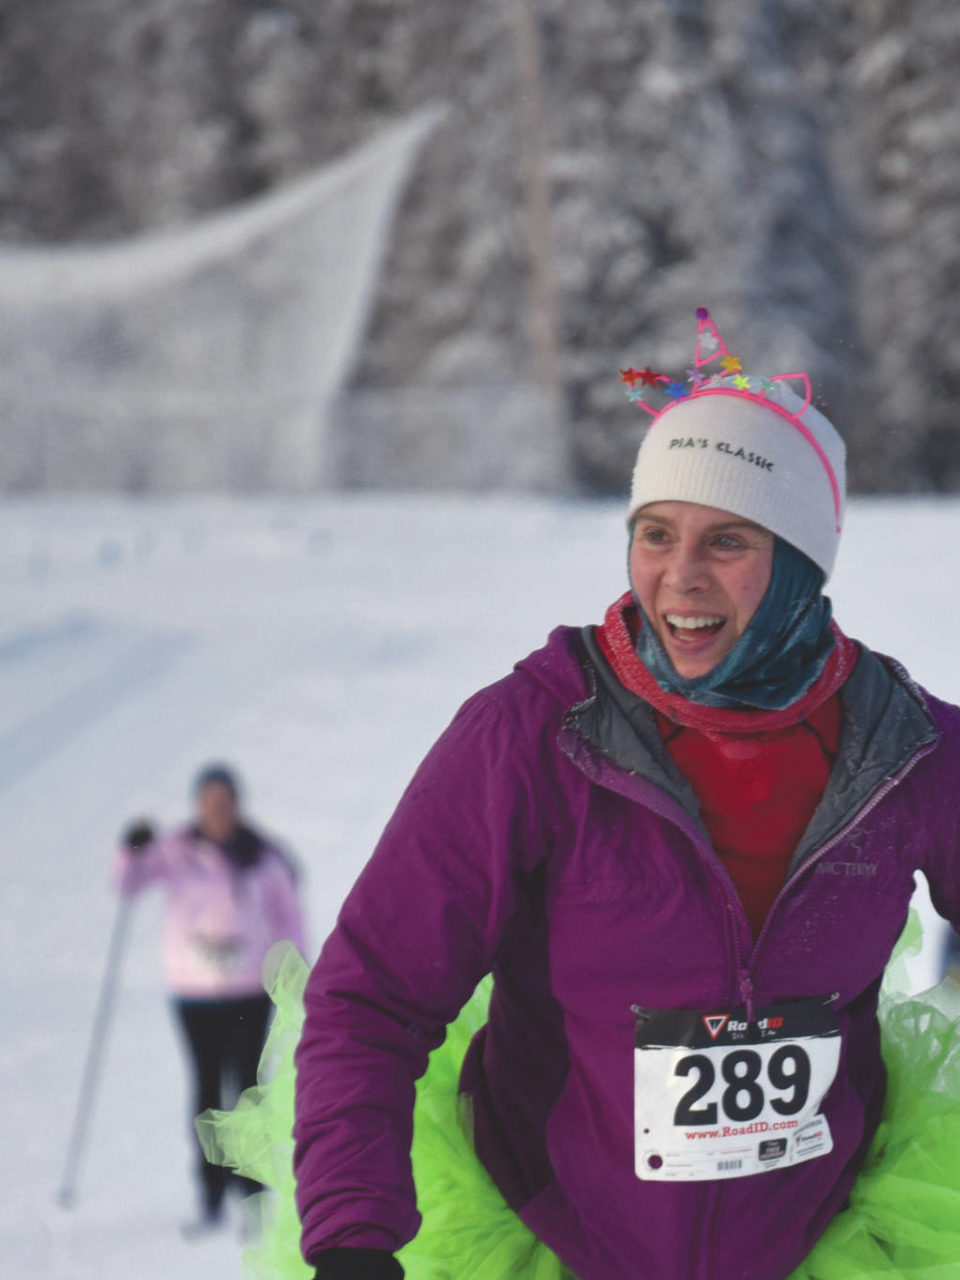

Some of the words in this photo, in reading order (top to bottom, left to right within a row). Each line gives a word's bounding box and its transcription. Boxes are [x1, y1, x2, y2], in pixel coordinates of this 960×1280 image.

[668, 438, 709, 450] PIA'S
[716, 442, 774, 472] CLASSIC
[727, 1016, 784, 1032] RodID
[674, 1044, 811, 1126] 289
[684, 1119, 799, 1140] www.RoadID.com
